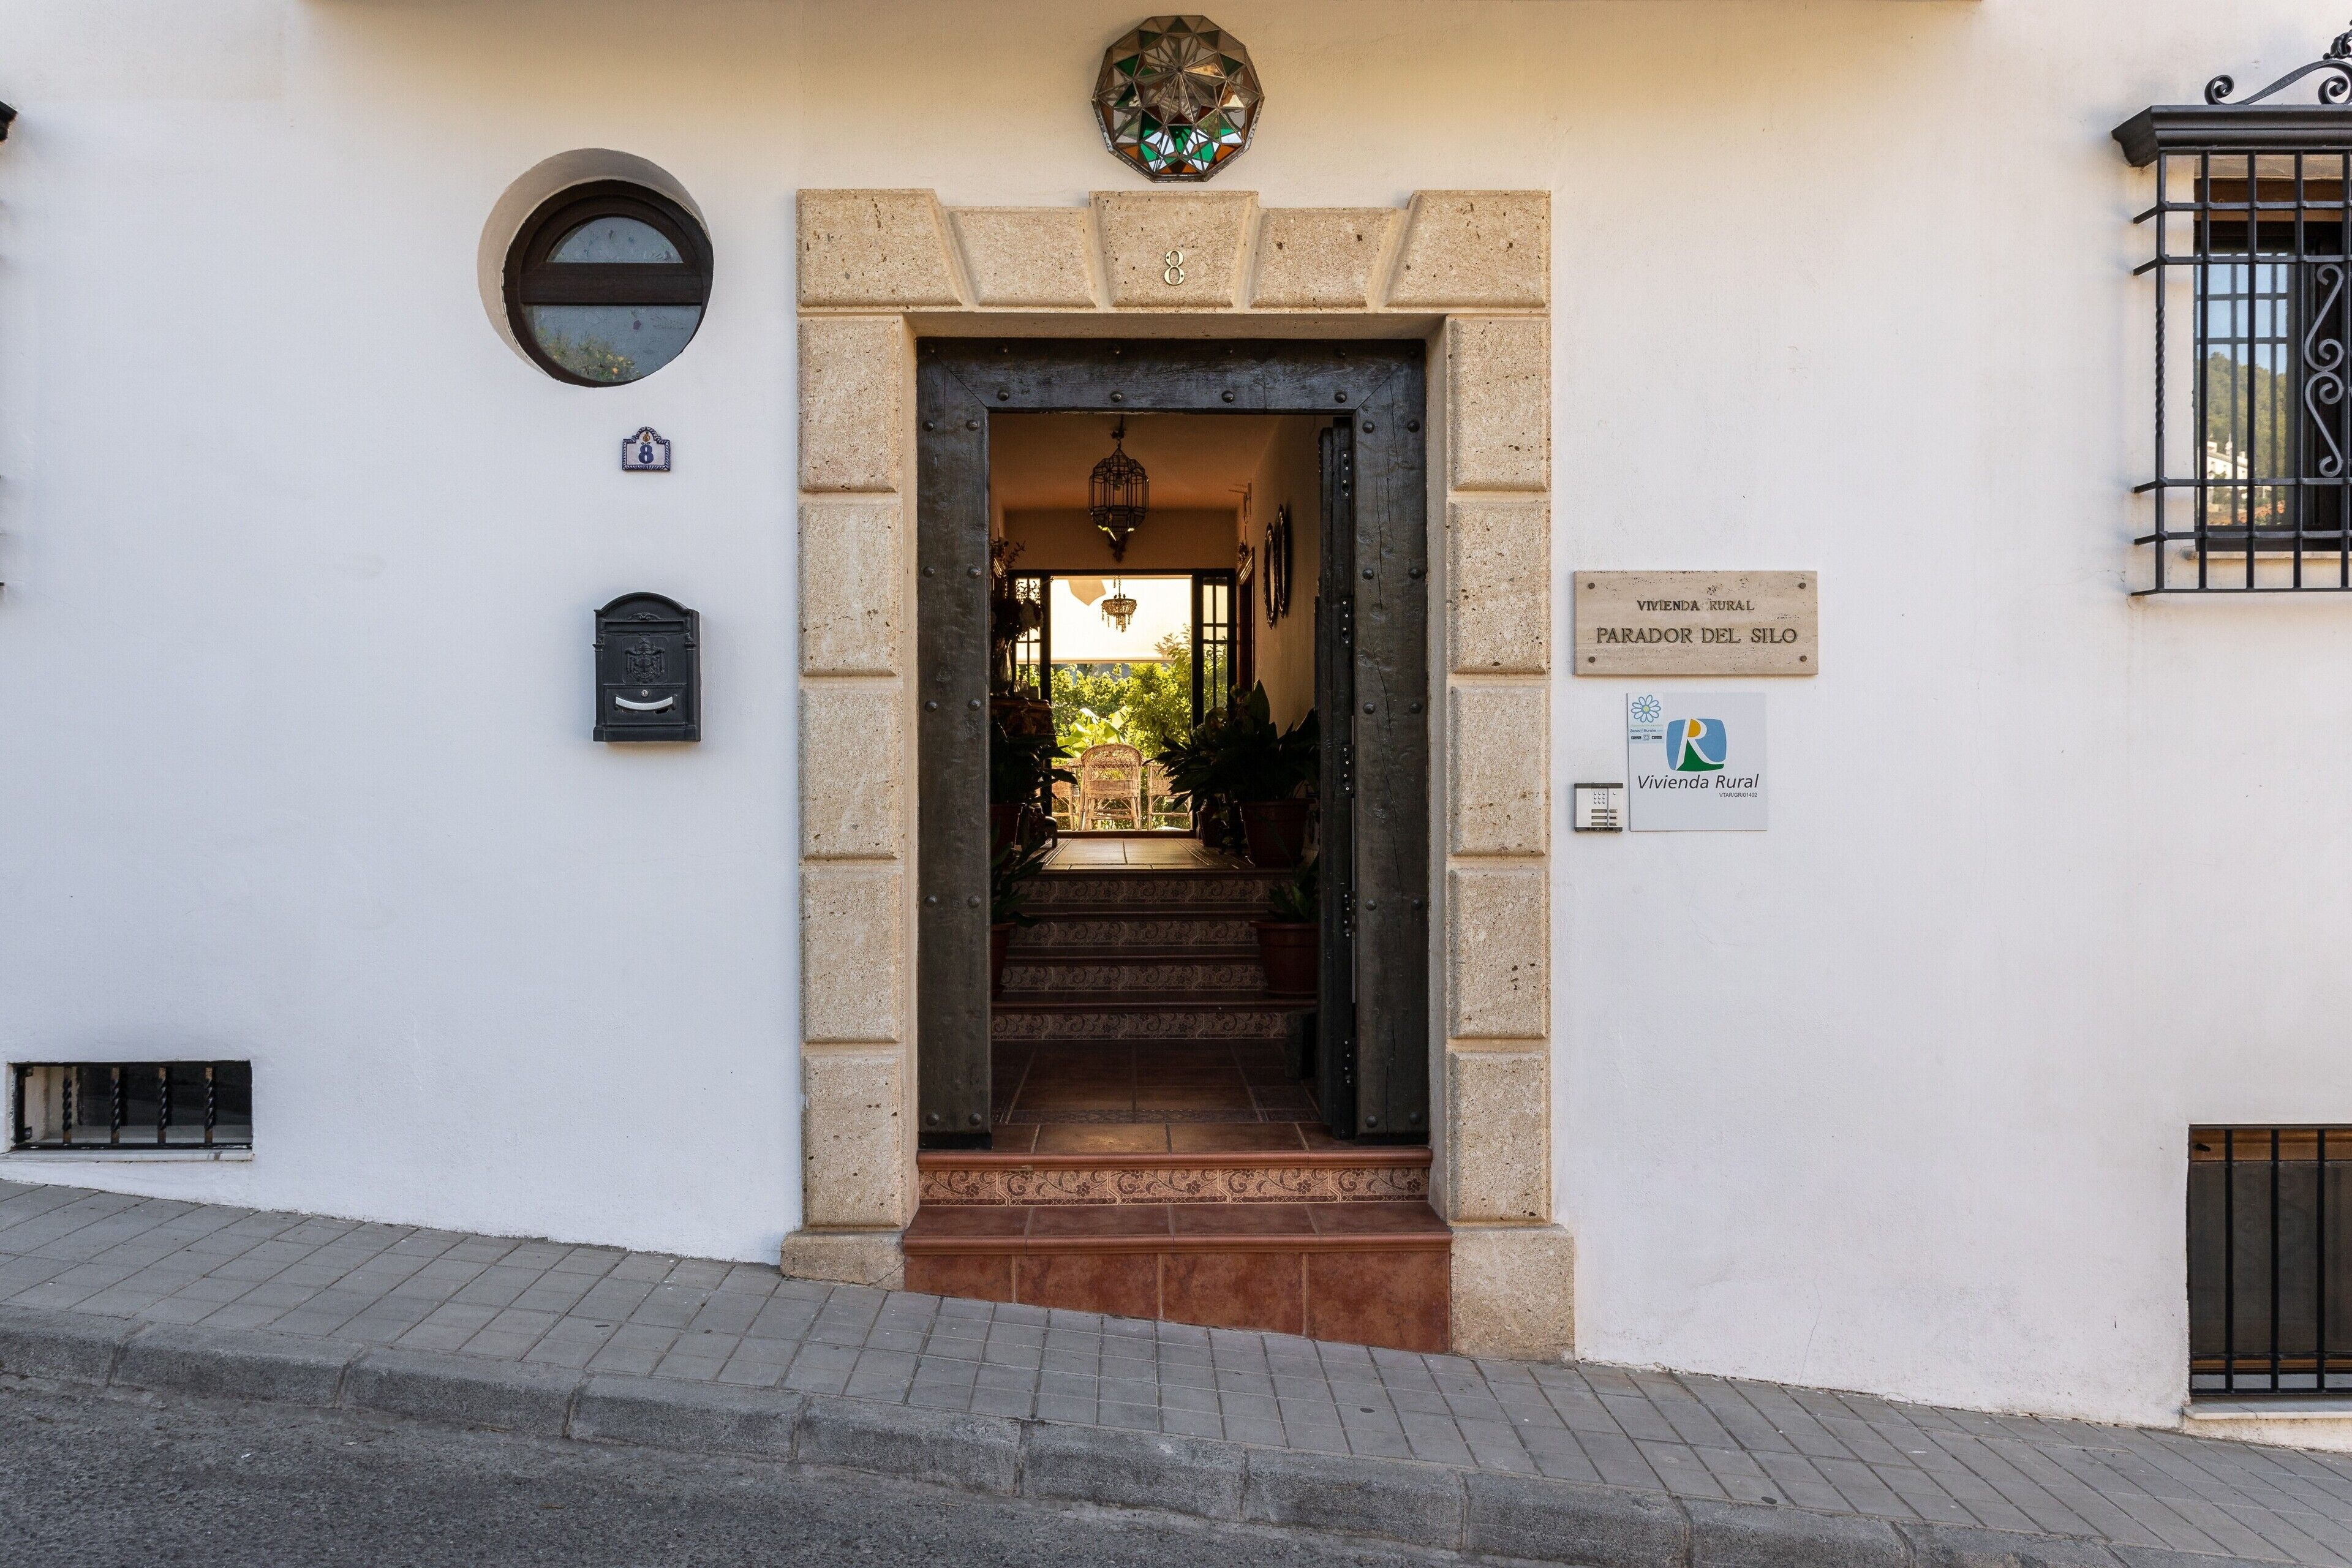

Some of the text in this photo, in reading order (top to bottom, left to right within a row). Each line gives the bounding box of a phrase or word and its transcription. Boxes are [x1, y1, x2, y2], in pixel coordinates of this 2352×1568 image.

[1164, 250, 1185, 285] 8
[638, 445, 654, 464] 8
[1637, 600, 1755, 611] VIVIENDA RURAL
[1596, 627, 1798, 644] PARADOR DEL SILO
[1638, 774, 1759, 789] Vivienda Rural
